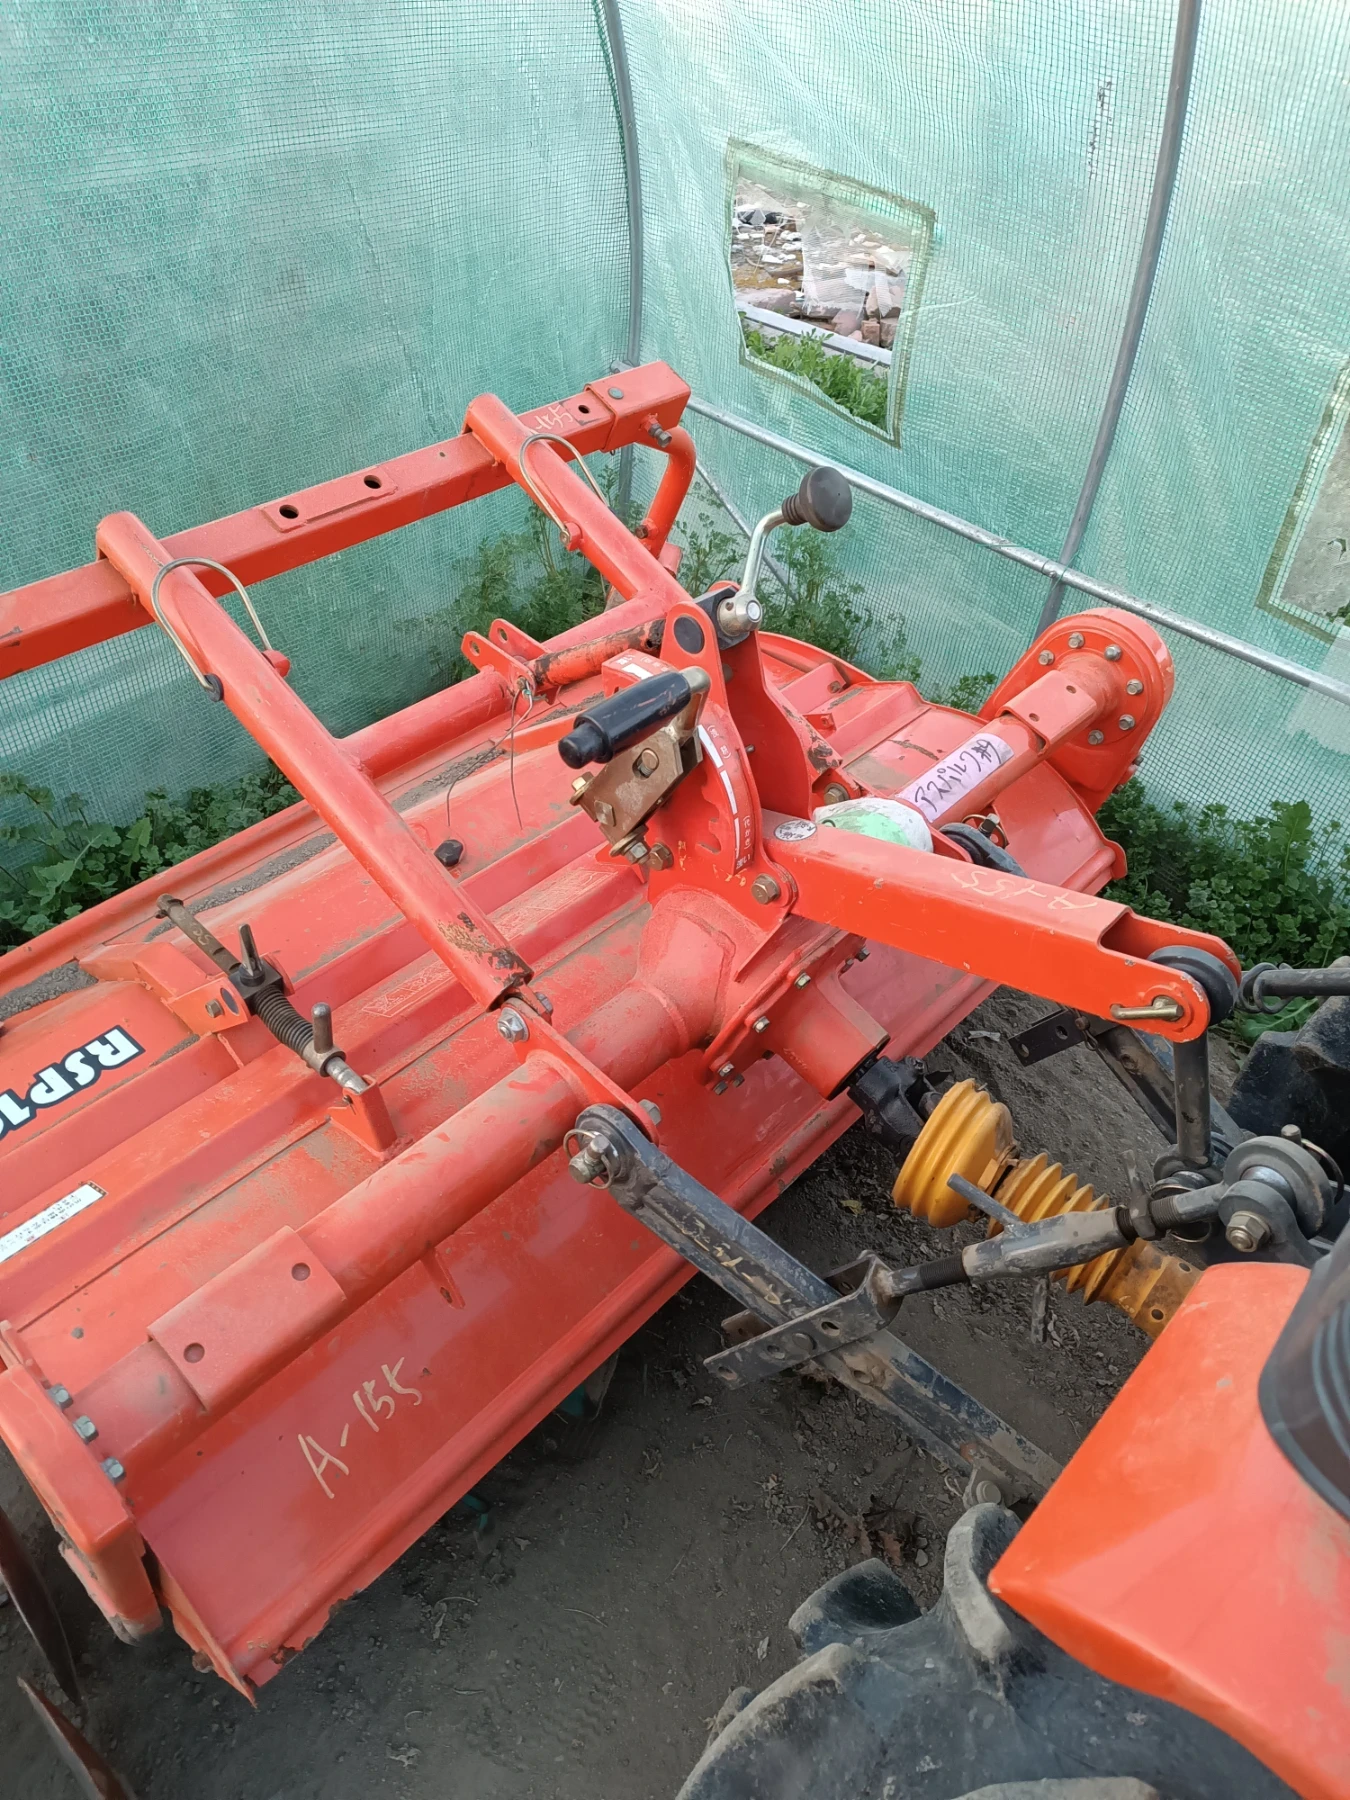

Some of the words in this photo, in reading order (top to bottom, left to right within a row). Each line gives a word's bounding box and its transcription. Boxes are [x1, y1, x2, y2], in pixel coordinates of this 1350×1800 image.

[950, 870, 1098, 910] A-155
[0, 1026, 143, 1138] RSP1
[298, 1356, 423, 1499] A-155
